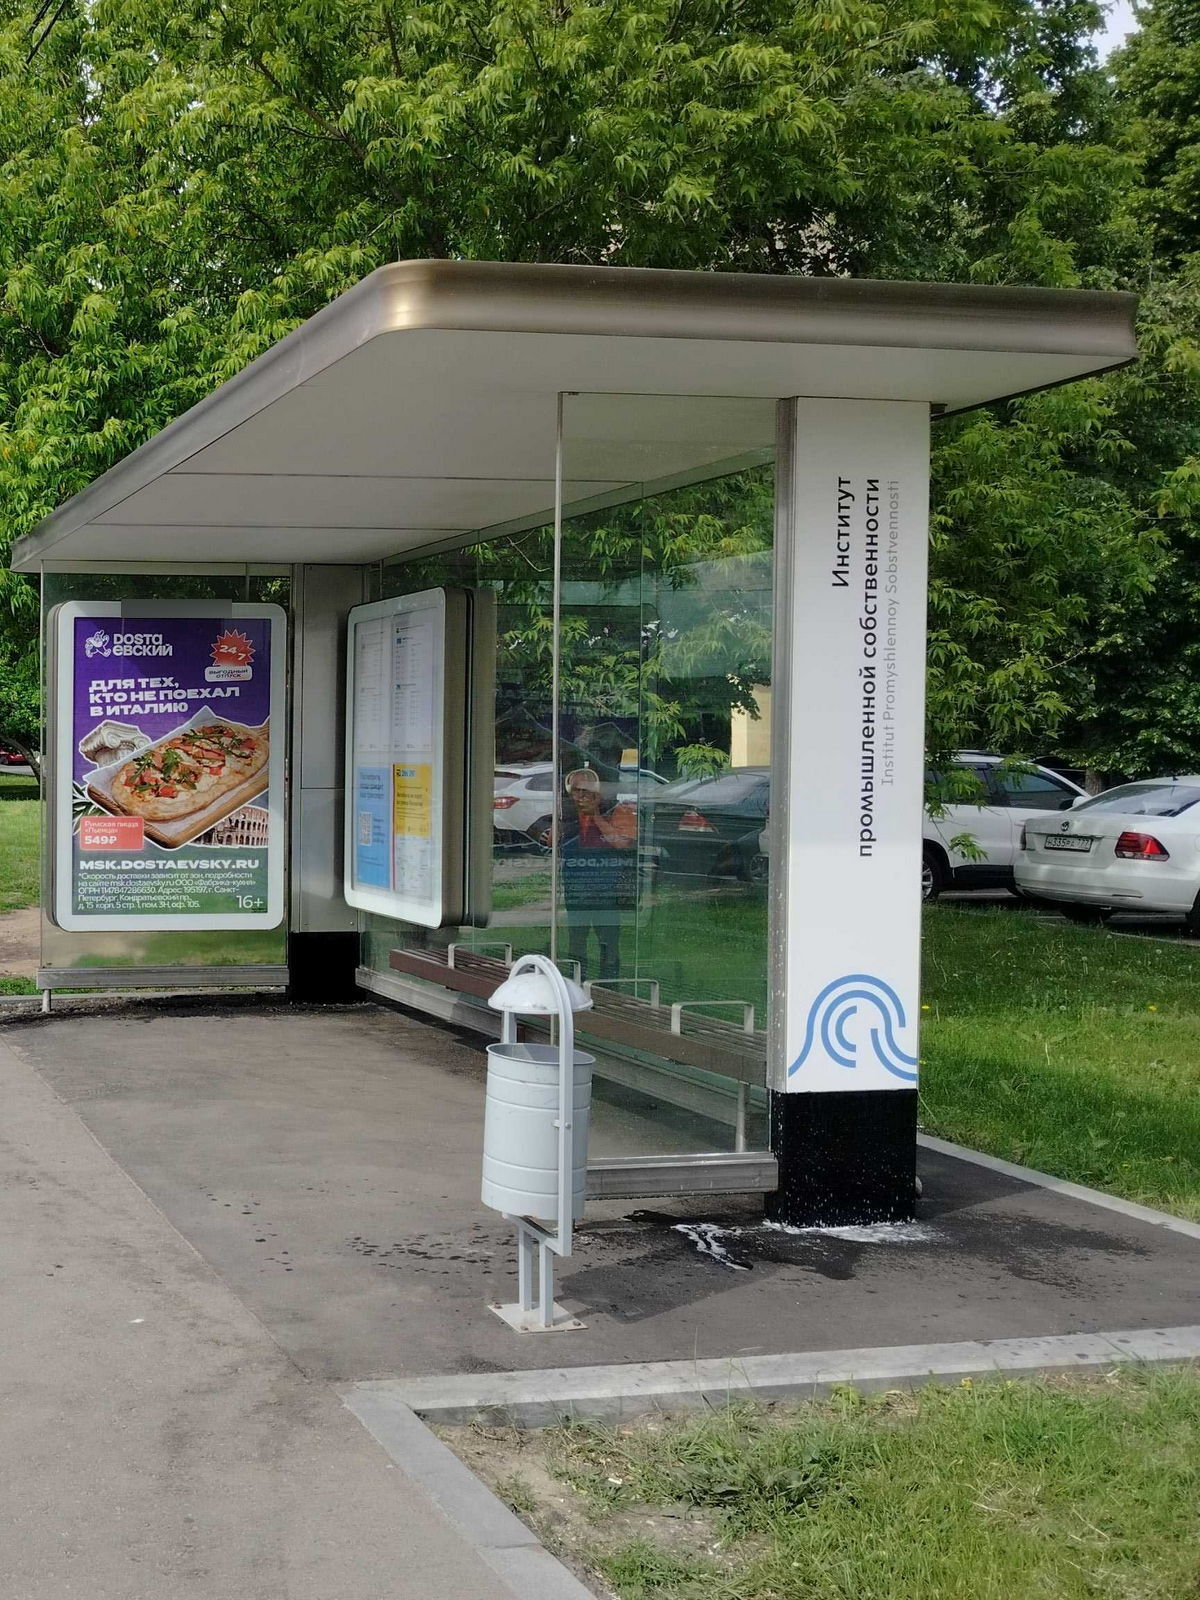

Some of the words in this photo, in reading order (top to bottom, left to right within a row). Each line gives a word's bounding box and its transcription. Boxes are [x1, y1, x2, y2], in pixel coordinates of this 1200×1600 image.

[832, 477, 855, 587] Институт
[886, 479, 900, 593] Sobstvennosti
[859, 478, 880, 659] собственности
[88, 679, 135, 692] ДЛЯ
[137, 677, 180, 689] ТЕХ,
[883, 598, 899, 721] Promyshlennoy
[89, 691, 126, 704] КТО
[131, 690, 156, 702] НЕ
[158, 686, 240, 700] ПОЕХАЛ
[89, 705, 104, 717] В
[106, 702, 188, 716] ИТАЛИЮ
[857, 664, 877, 858] промышленной
[881, 726, 895, 786] Institut
[79, 859, 260, 870] MSK.DOSTAEVSKY.RU
[236, 895, 264, 909] 16+
